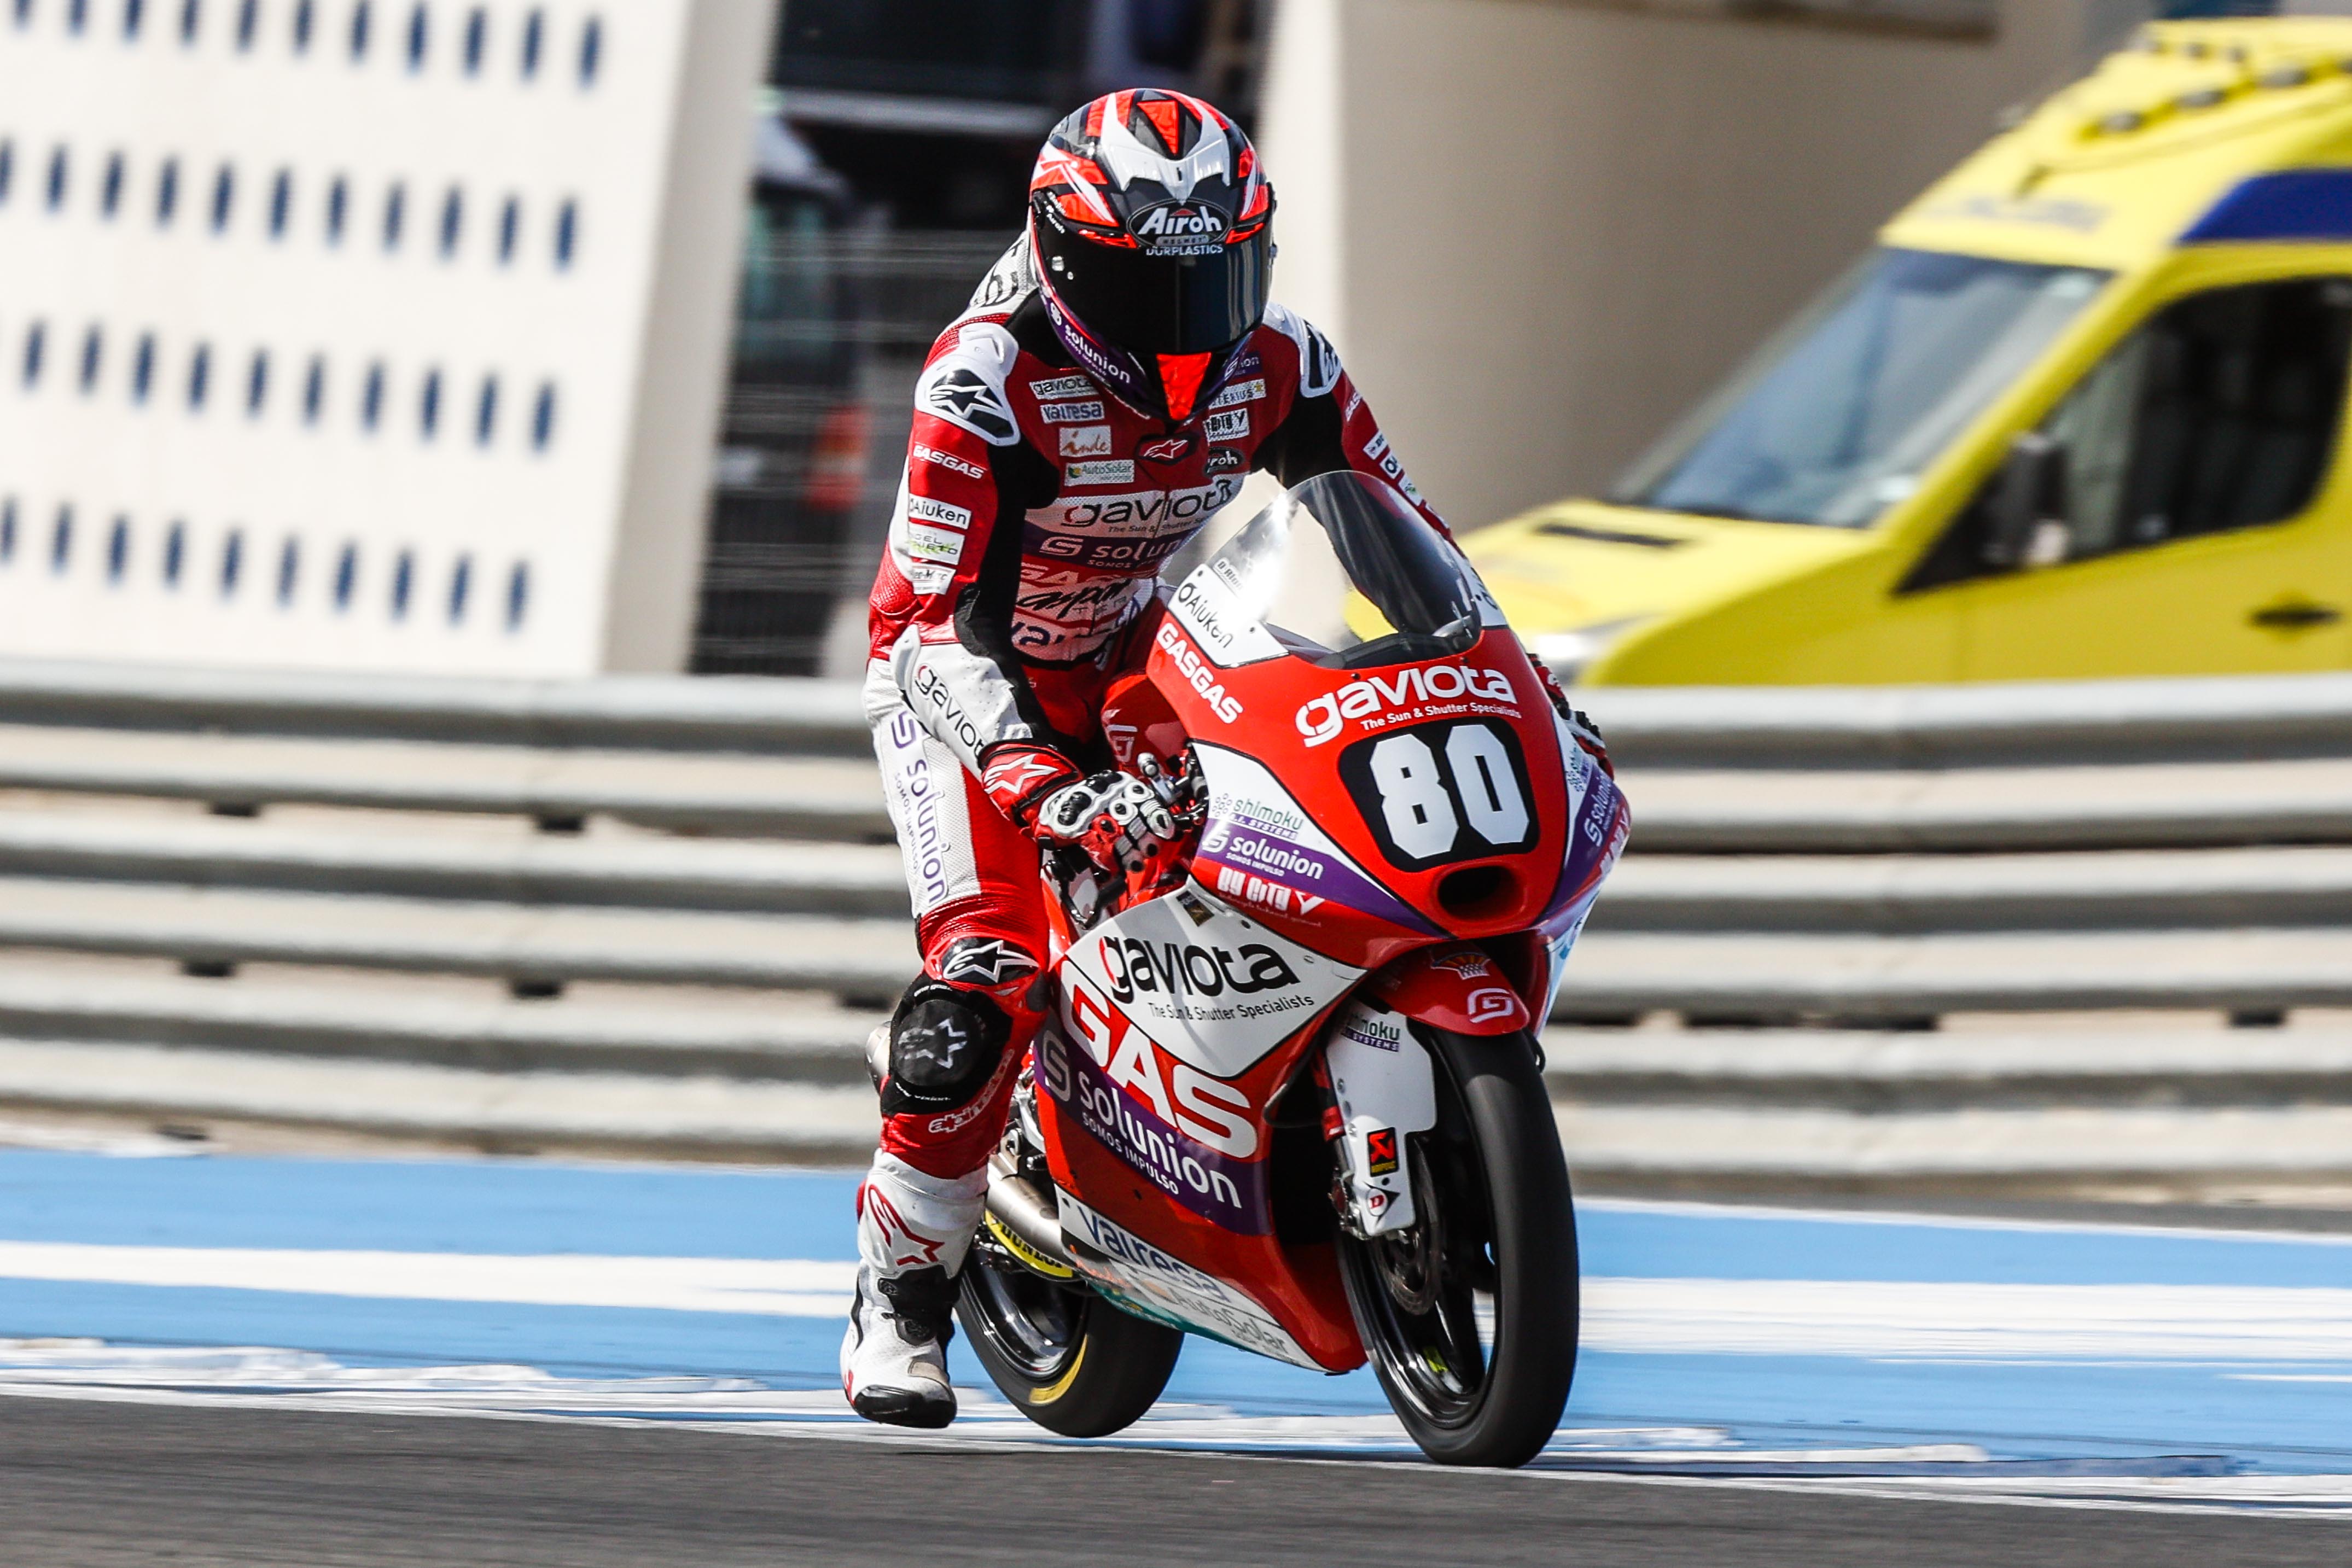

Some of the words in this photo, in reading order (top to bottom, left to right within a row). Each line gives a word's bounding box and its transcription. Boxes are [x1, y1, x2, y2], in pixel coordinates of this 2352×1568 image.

[1138, 206, 1222, 235] Airoh
[1064, 324, 1131, 383] solunion
[912, 445, 984, 479] GASGAS
[1061, 479, 1232, 528] gaviota
[1155, 622, 1244, 724] GASGAS
[914, 665, 985, 759] gaviot
[1295, 666, 1517, 748] gaviota
[1360, 718, 1386, 731] The
[1387, 712, 1412, 724] Sun
[1413, 708, 1424, 718] &
[1427, 704, 1468, 716] Shutter
[1233, 798, 1304, 830] shimoku
[1370, 725, 1530, 860] 80
[906, 758, 948, 902] solunion
[1229, 837, 1324, 879] solunion
[1248, 819, 1299, 841] SYSTEMS
[1225, 853, 1251, 866] SOMOS
[1251, 860, 1285, 877] IMPULSO
[1098, 936, 1301, 1004] gaviota
[1149, 1002, 1166, 1018] The
[1166, 1004, 1186, 1019] Sun
[1186, 1006, 1194, 1019] &
[1194, 1006, 1235, 1021] Shutter
[1236, 994, 1315, 1019] Specialists
[1061, 960, 1258, 1158] GAS
[1078, 1071, 1242, 1209] solunion
[1082, 1111, 1123, 1153] SOMOS
[1124, 1145, 1179, 1195] IMPULSO
